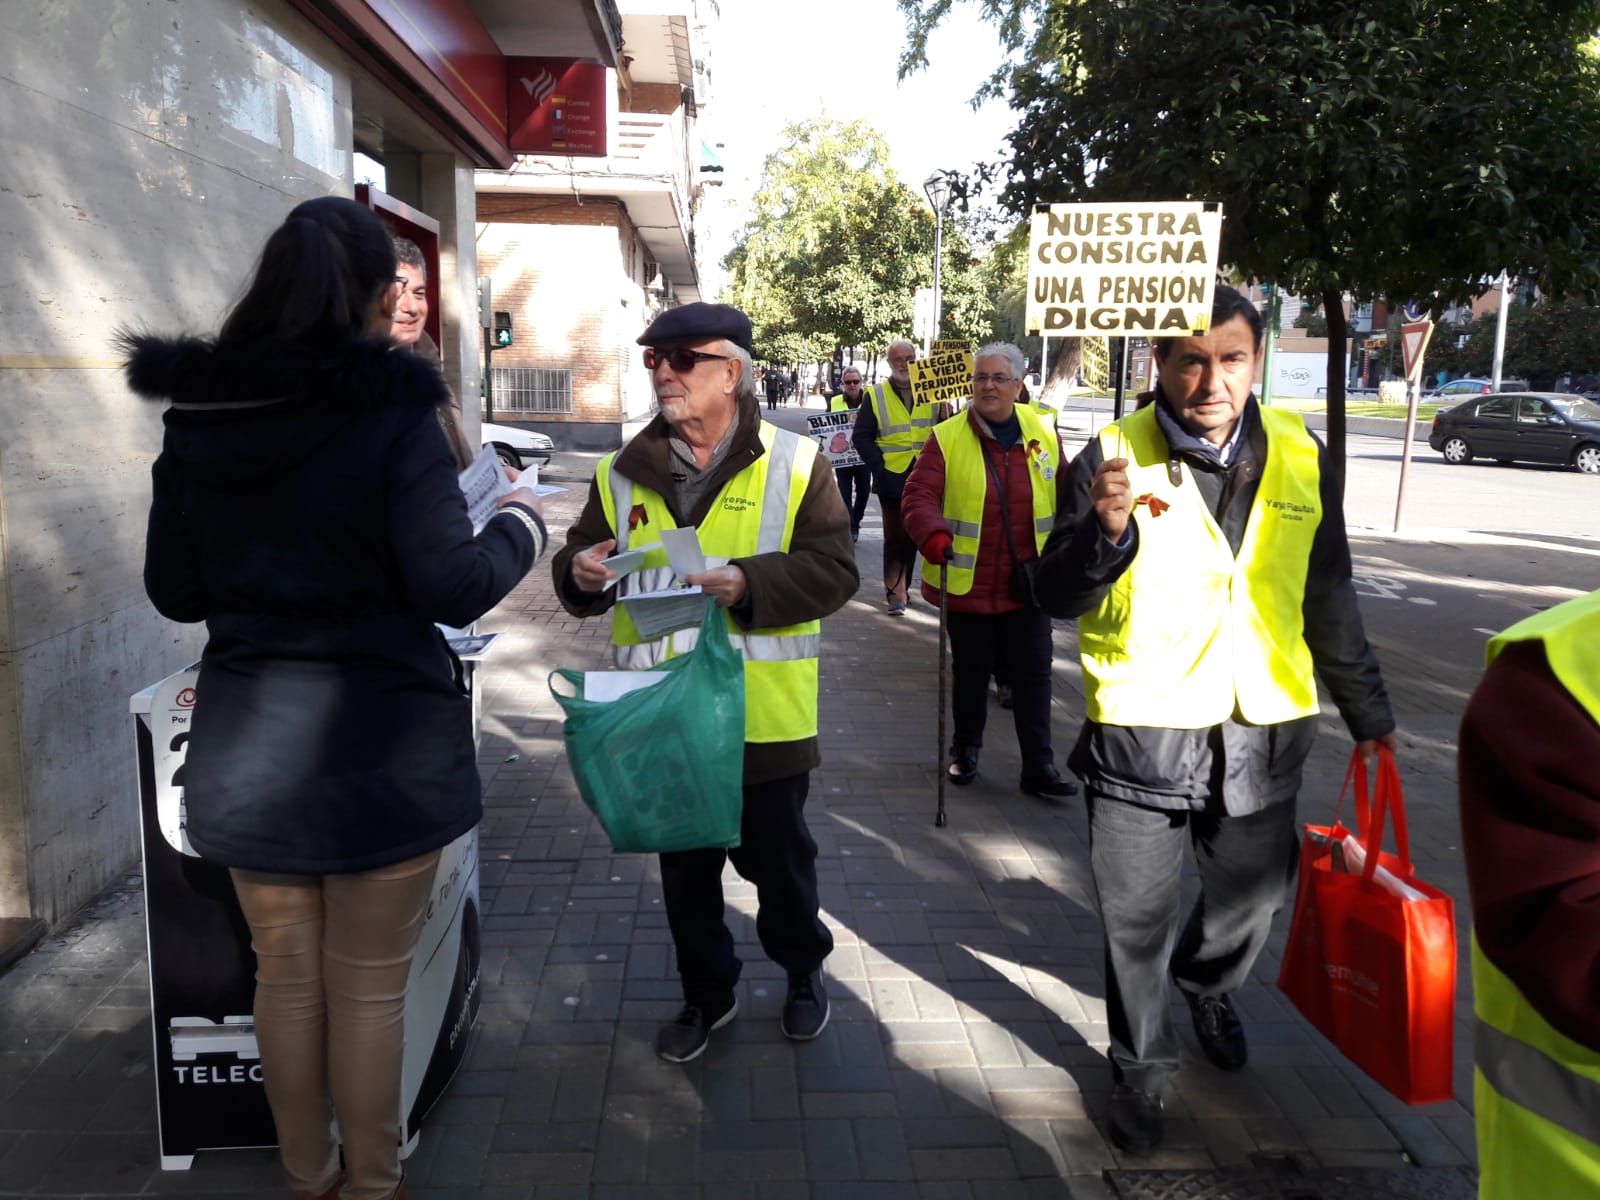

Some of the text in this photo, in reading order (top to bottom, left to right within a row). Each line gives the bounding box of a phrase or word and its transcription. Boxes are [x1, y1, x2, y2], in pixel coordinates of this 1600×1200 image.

[1047, 212, 1202, 236] NUESTRA
[1037, 241, 1208, 264] CONSIGNA
[1034, 276, 1084, 304] UNA
[1043, 307, 1190, 330] DIGNA
[931, 341, 940, 350] LAS
[917, 352, 963, 370] LLEGAR
[918, 363, 967, 380] A VIEJO
[914, 373, 973, 392] PERJUDICA
[917, 392, 930, 404] AL
[171, 716, 188, 724] Por
[172, 1065, 264, 1084] TELEC
